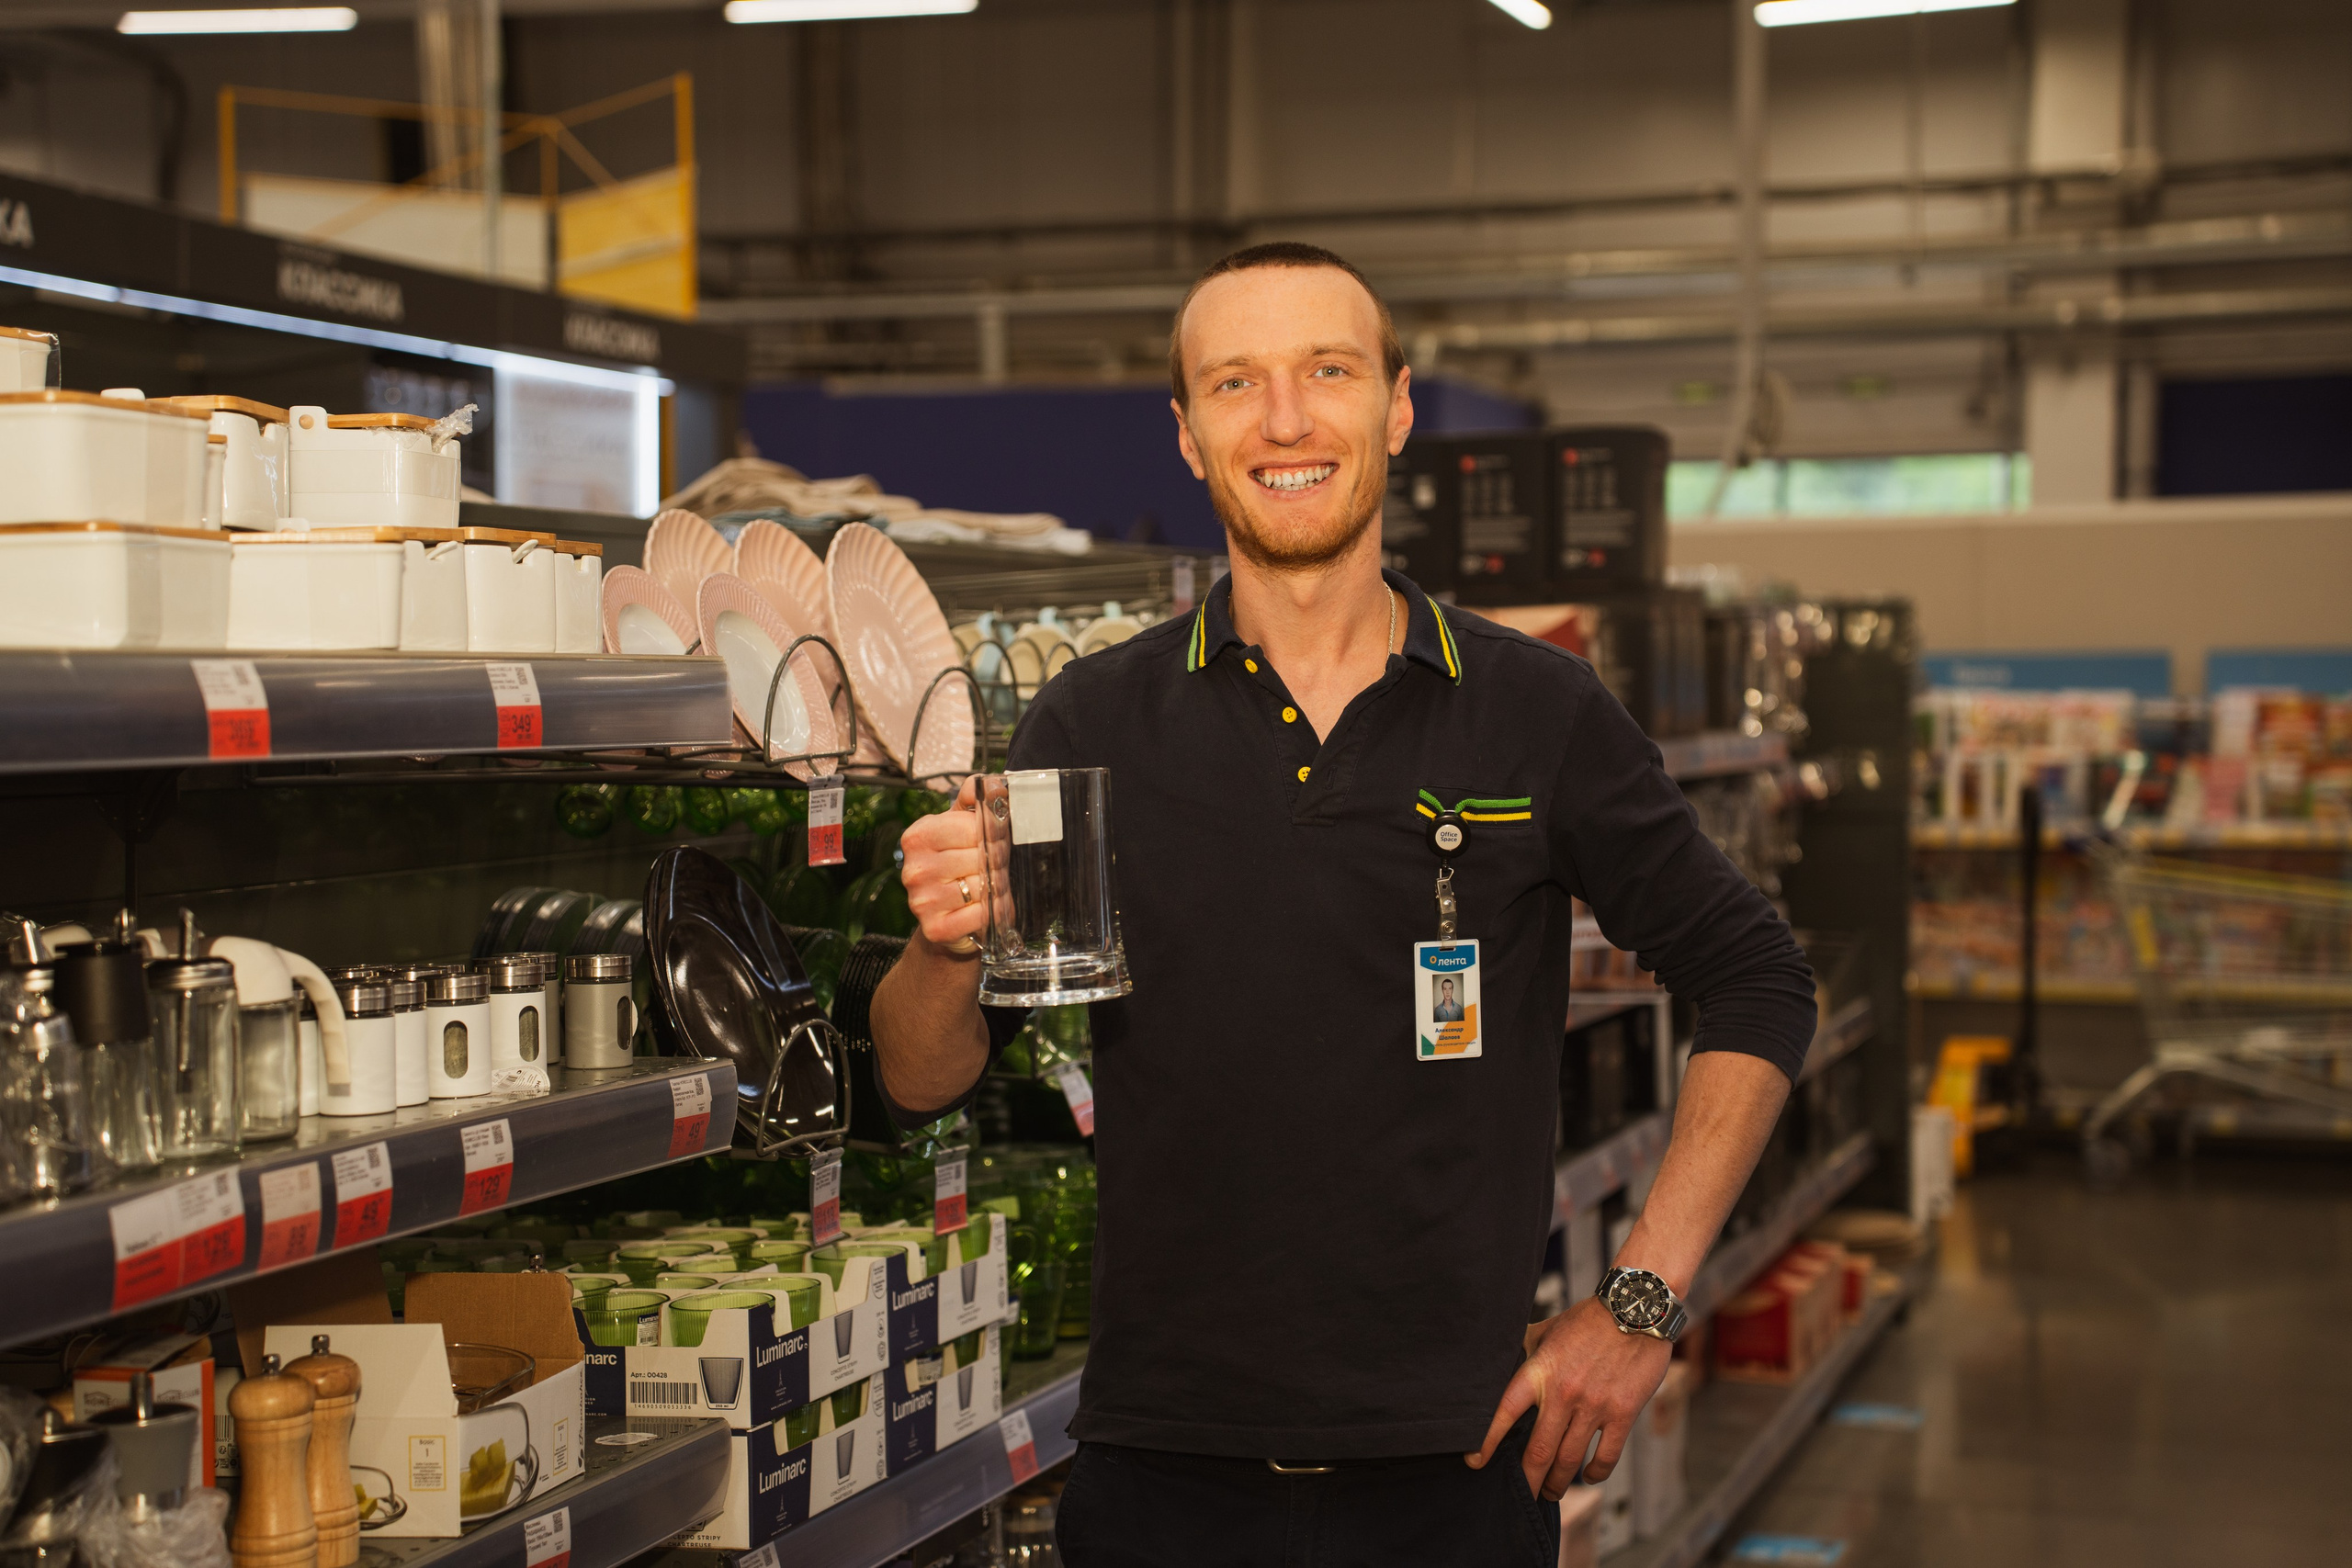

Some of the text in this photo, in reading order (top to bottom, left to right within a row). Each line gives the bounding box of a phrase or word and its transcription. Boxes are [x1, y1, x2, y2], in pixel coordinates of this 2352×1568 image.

[512, 714, 531, 733] 349
[1438, 956, 1466, 966] лента
[688, 1122, 700, 1140] 49
[480, 1175, 501, 1196] 129
[892, 1281, 935, 1312] Luminarc
[756, 1335, 804, 1369] Luminarc
[892, 1390, 933, 1423] Luminarc
[759, 1458, 807, 1495] Luminarc
